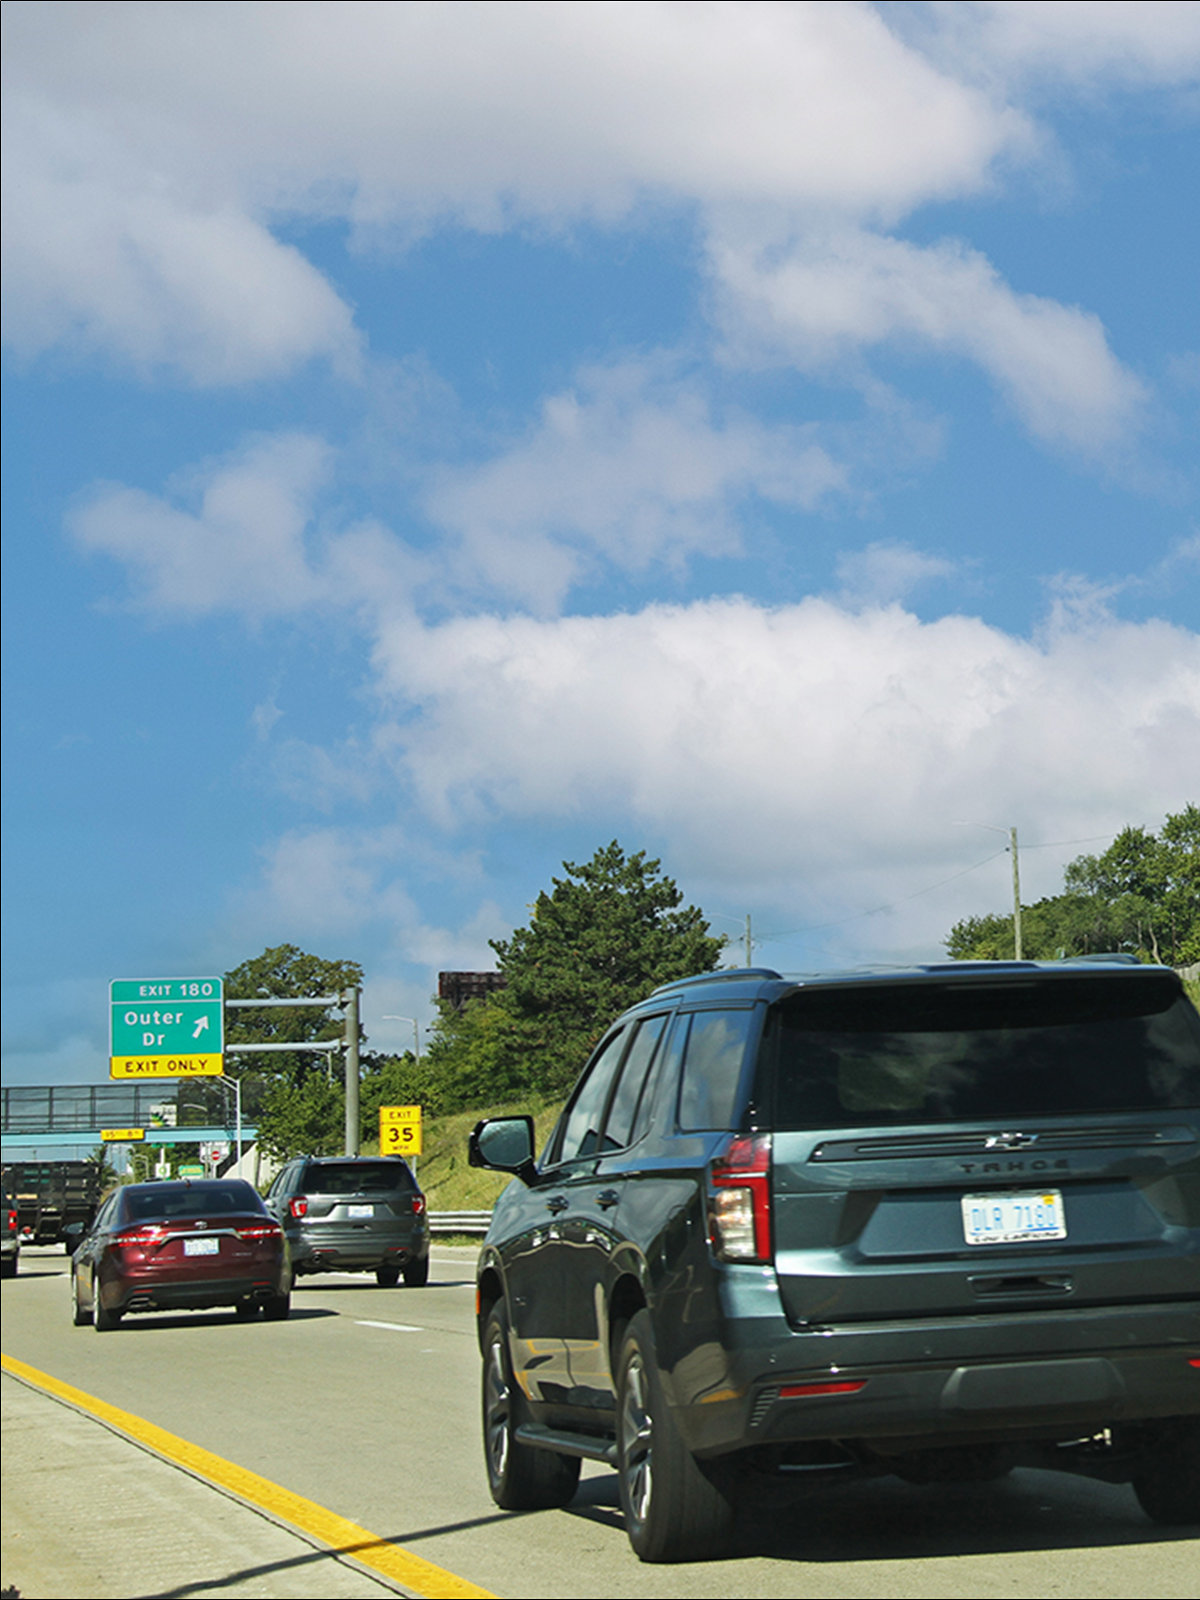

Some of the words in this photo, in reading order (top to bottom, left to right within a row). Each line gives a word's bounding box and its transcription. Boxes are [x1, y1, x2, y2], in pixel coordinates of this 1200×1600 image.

[139, 985, 171, 996] EXIT
[180, 983, 213, 996] 180
[124, 1011, 183, 1025] Outer
[143, 1032, 165, 1046] Dr
[125, 1061, 158, 1073] EXIT
[167, 1060, 208, 1071] ONLY
[389, 1111, 411, 1119] EXIT
[389, 1127, 414, 1142] 35
[961, 1159, 1068, 1173] TAHOE
